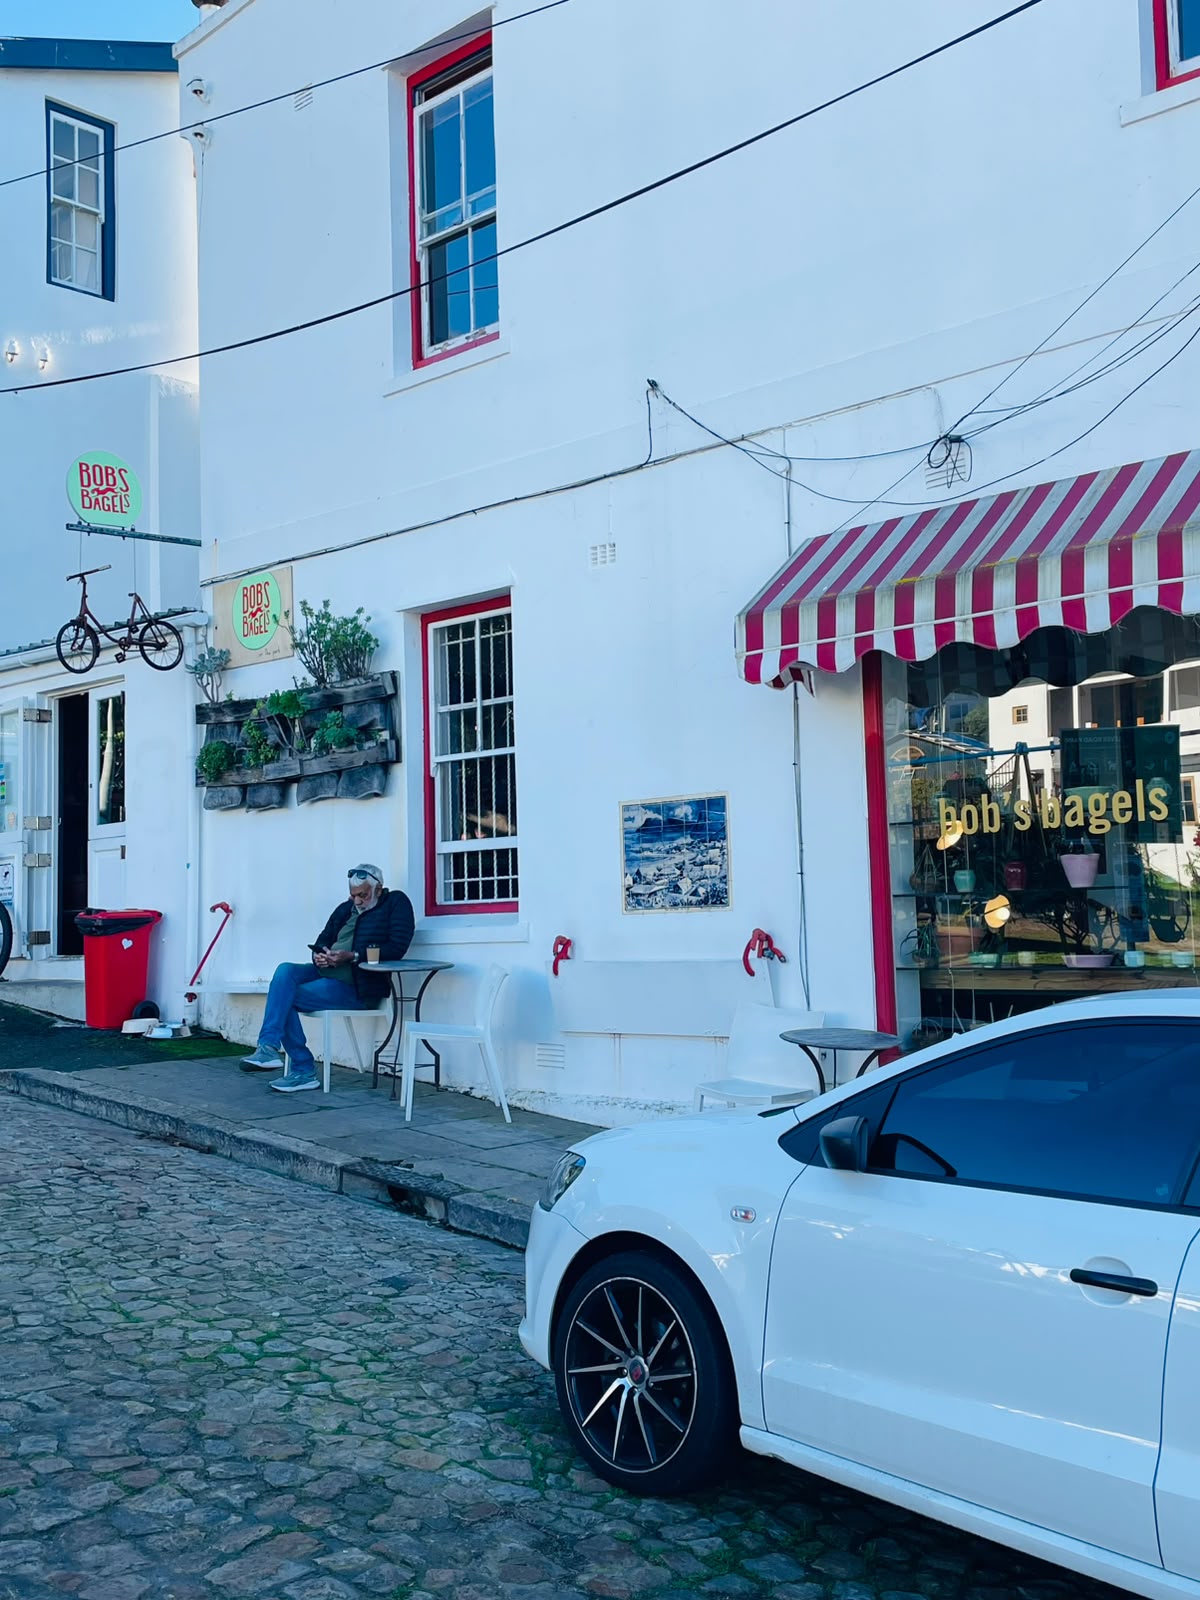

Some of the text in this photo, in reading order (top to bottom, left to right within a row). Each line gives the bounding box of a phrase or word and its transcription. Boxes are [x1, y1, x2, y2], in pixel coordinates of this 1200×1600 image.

[81, 488, 130, 514] BAGELS
[242, 610, 270, 637] BAGELS
[939, 779, 1169, 835] bob's bagels
